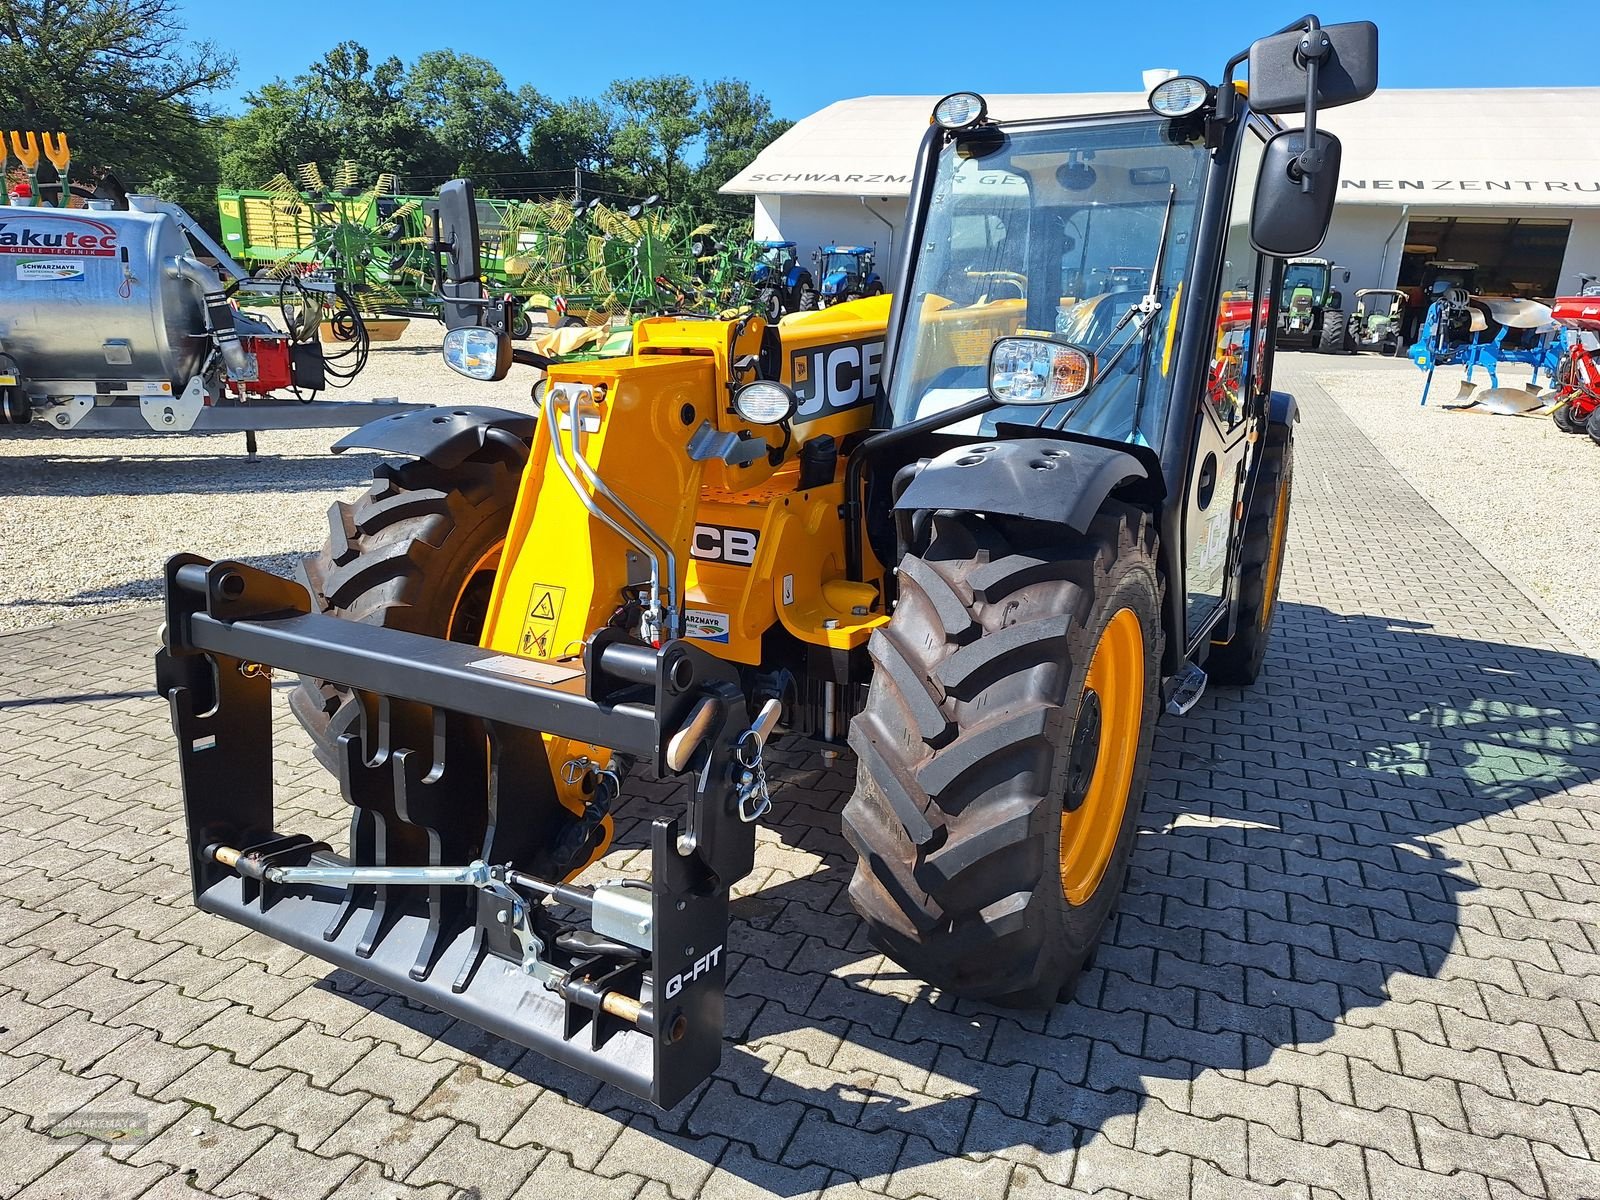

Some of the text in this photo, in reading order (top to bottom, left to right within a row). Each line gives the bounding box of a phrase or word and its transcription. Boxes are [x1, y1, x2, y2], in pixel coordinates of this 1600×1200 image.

[749, 173, 967, 184] SCHWARZMR
[1341, 179, 1600, 192] NENZENTRU
[795, 341, 885, 416] JCB
[690, 525, 757, 564] CB
[685, 615, 719, 627] ARZMAYR
[665, 944, 723, 1000] Q-FIT
